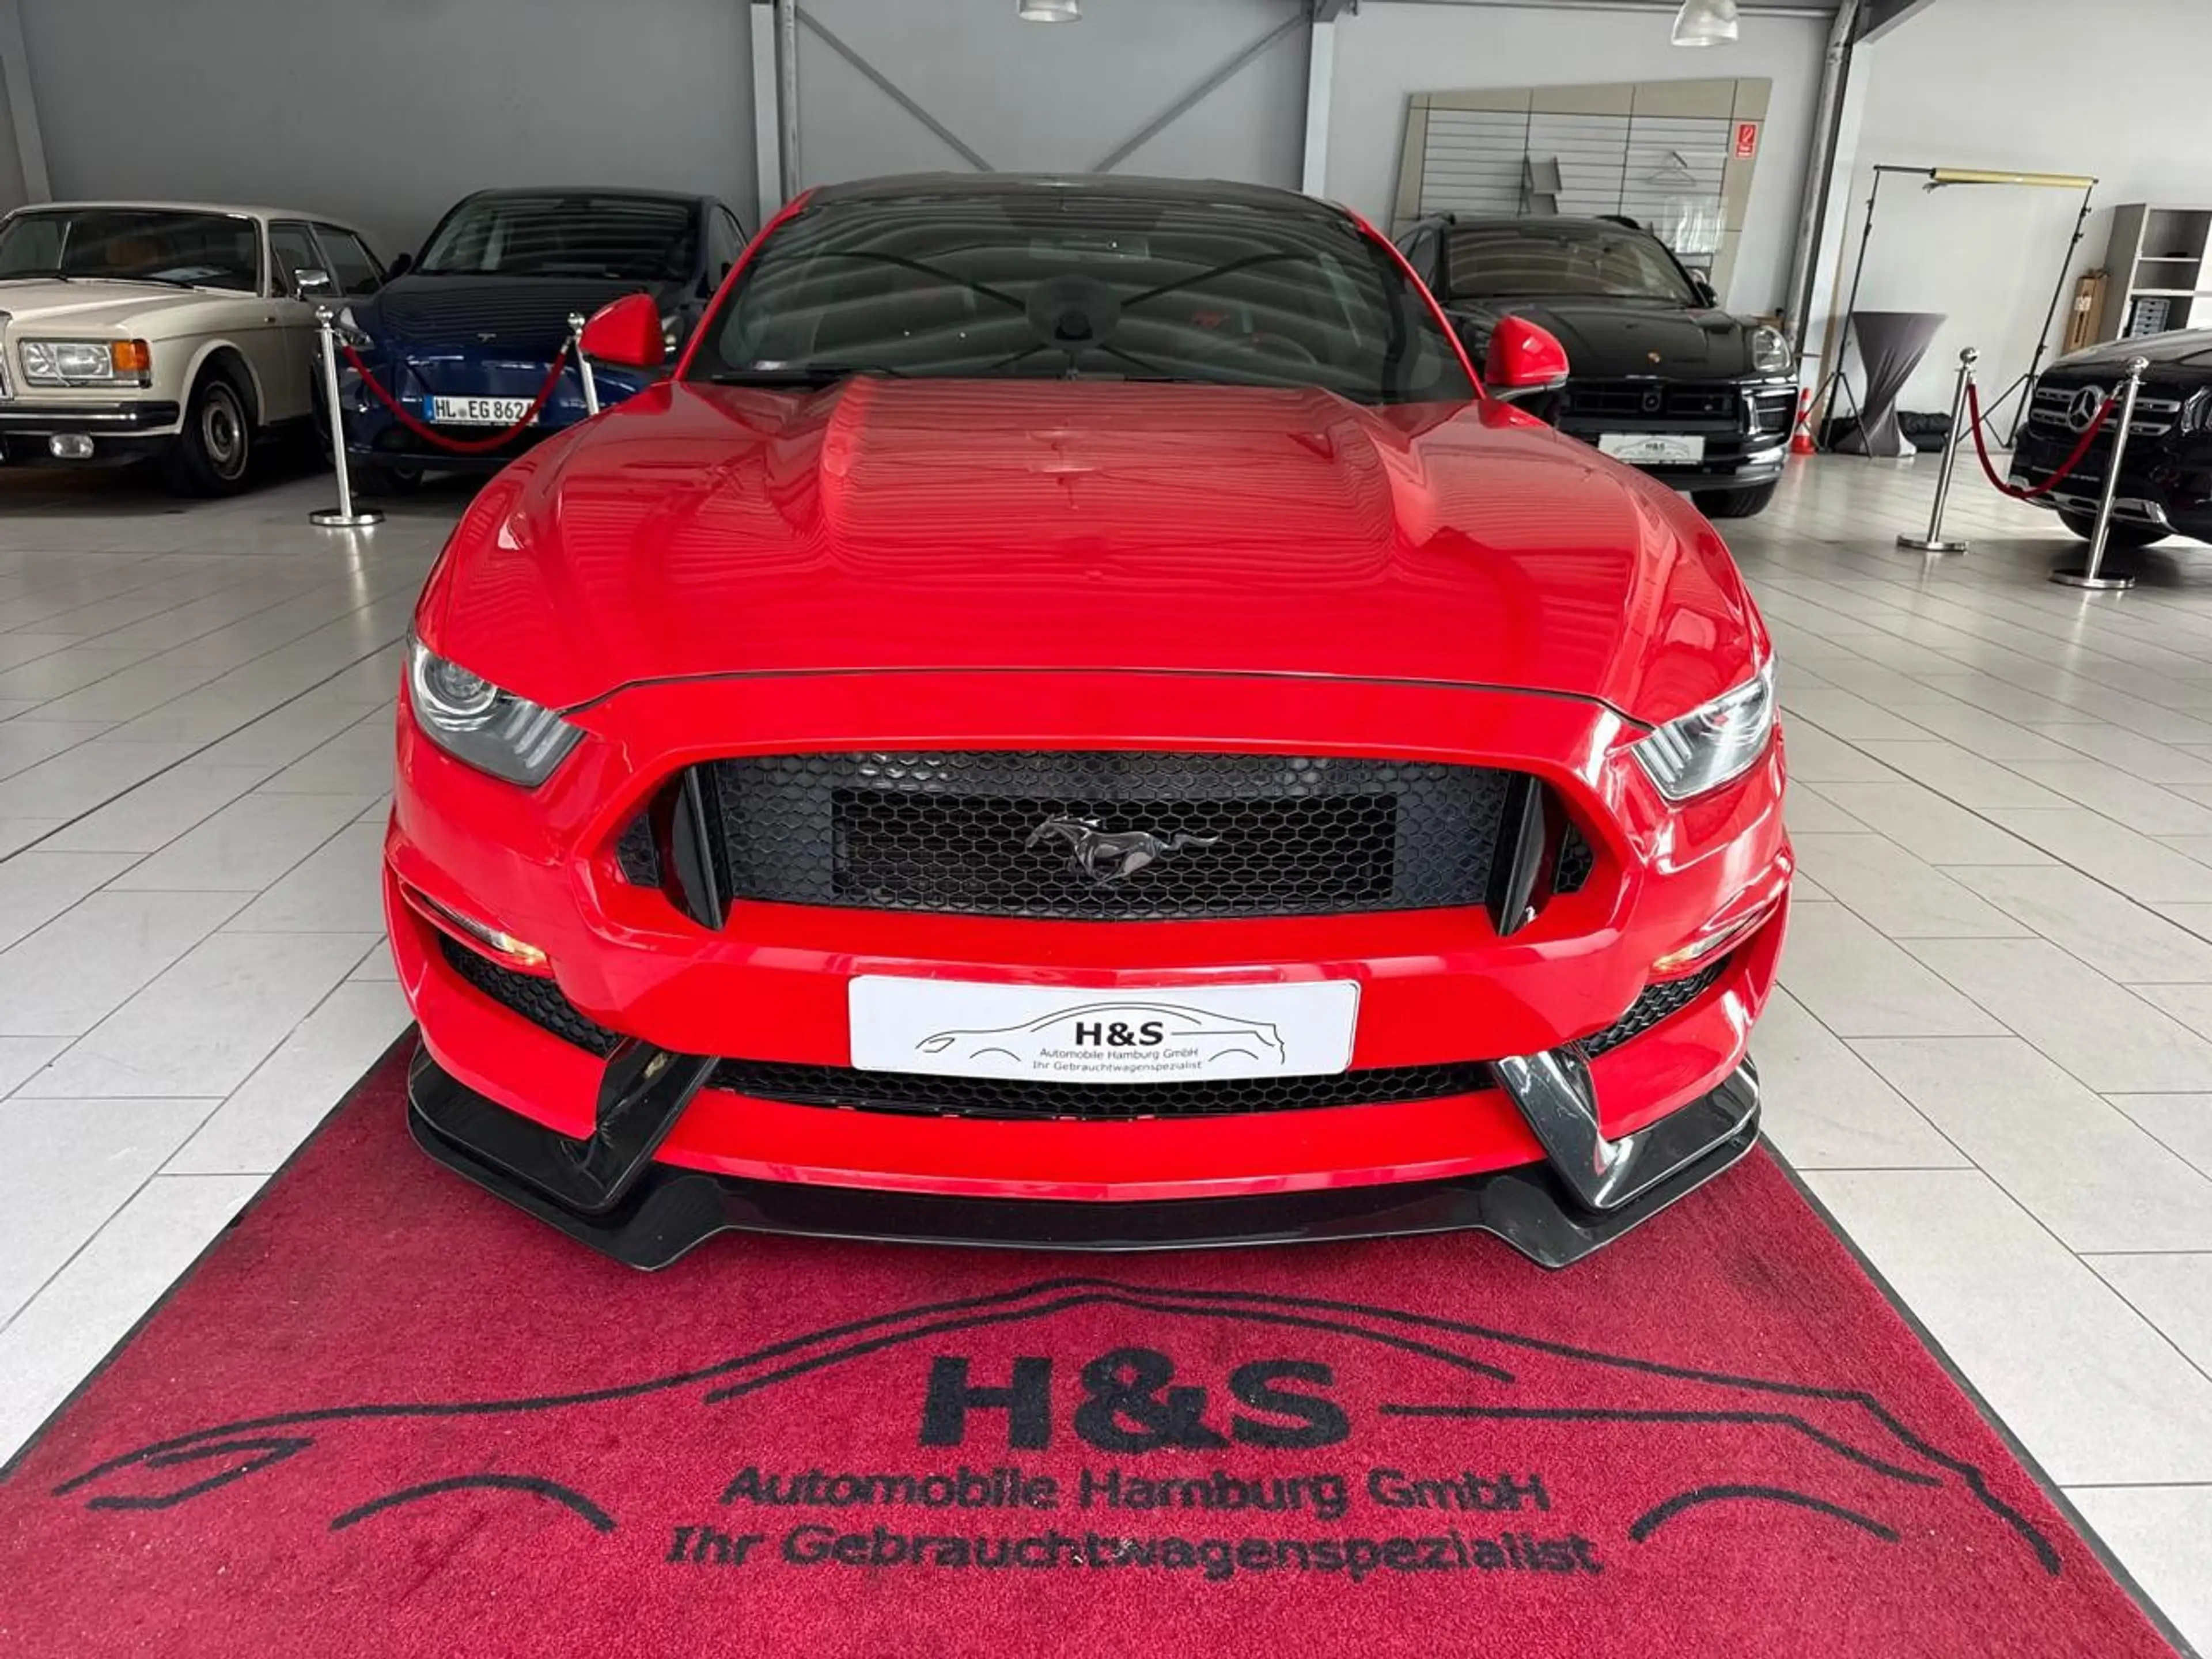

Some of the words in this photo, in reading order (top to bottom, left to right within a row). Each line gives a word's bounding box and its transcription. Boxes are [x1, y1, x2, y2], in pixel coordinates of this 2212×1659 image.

[435, 399, 456, 417] HL
[468, 400, 490, 418] EG
[494, 402, 532, 419] 862
[1075, 1021, 1164, 1046] H&S
[1033, 1060, 1050, 1070] Ihr
[1054, 1060, 1203, 1073] Gebrauchtwagenspezialist
[1040, 1048, 1103, 1059] Automobile
[1107, 1048, 1160, 1060] Hamburg
[1162, 1048, 1199, 1059] GmbH
[920, 1347, 1351, 1454] H&S
[718, 1465, 1060, 1509] Automobile
[1079, 1467, 1348, 1520] Hamburg
[1367, 1468, 1551, 1512] GmbH
[664, 1524, 765, 1566] Ihr
[781, 1524, 1604, 1583] Gebrauchtwagenspezialist
